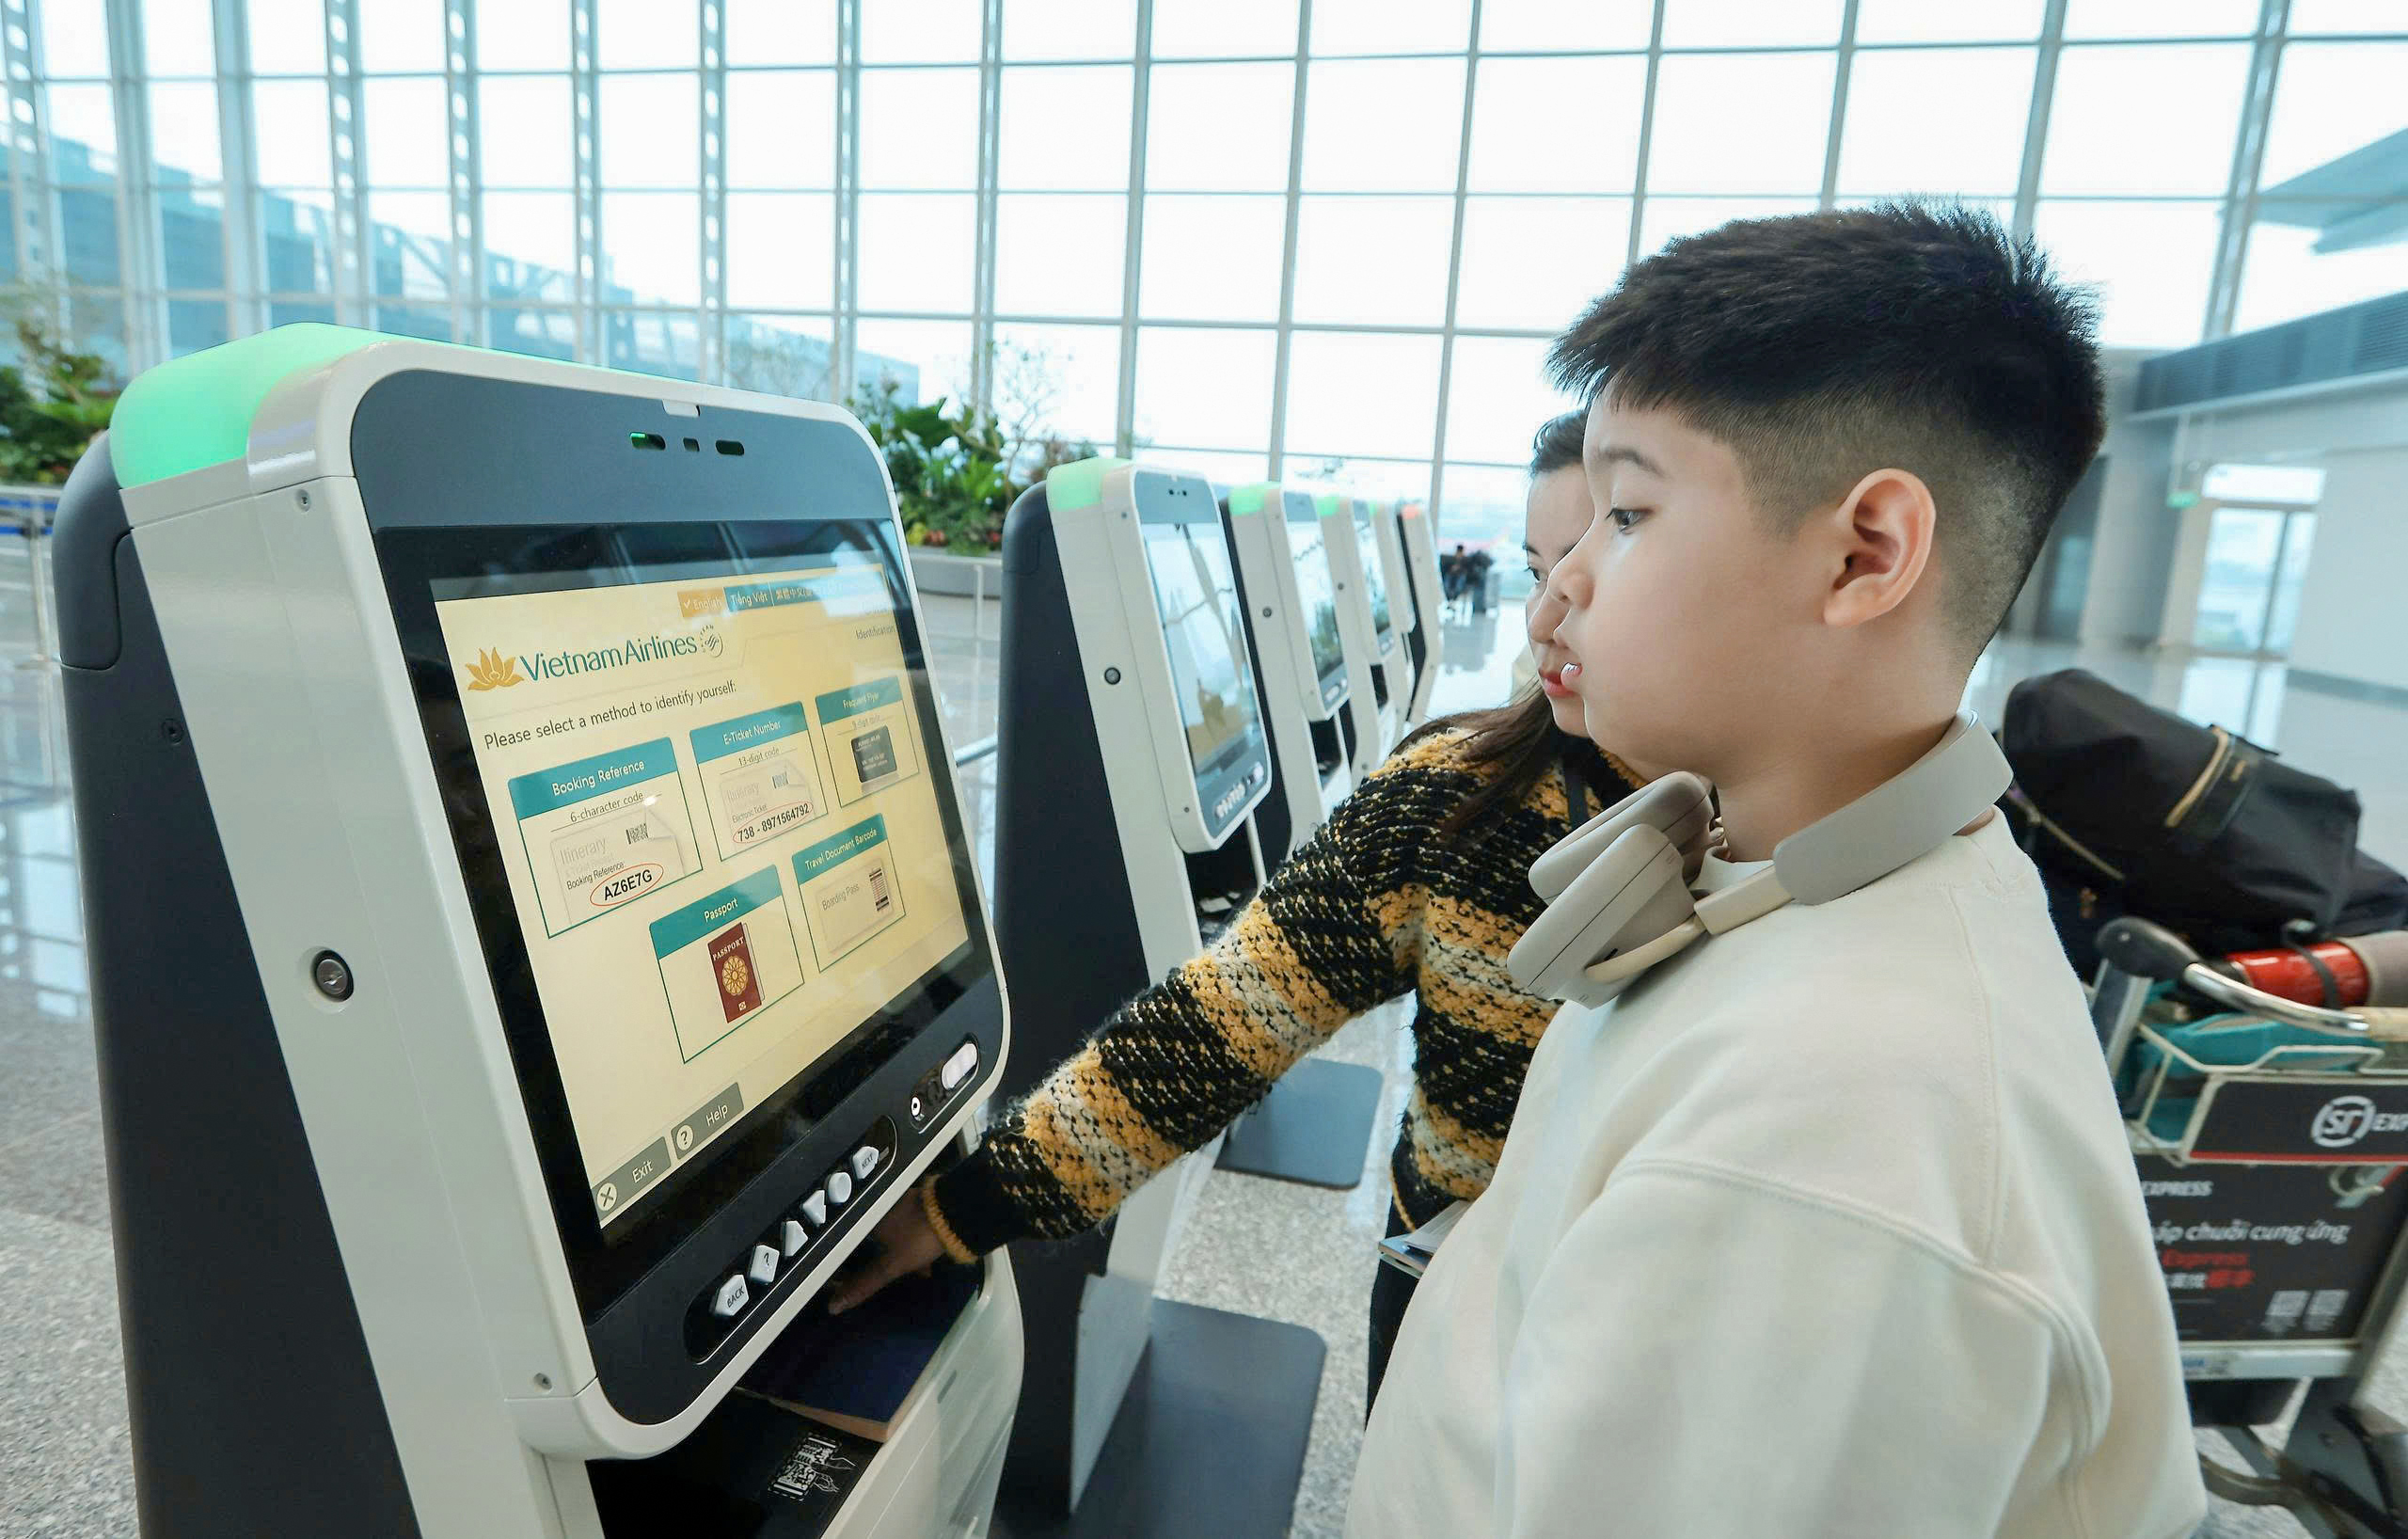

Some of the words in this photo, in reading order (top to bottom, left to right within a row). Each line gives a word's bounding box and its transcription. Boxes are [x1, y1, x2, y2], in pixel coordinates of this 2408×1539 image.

[483, 728, 531, 750] Please
[535, 718, 574, 738] select
[578, 717, 587, 728] a
[590, 706, 637, 726] method
[641, 701, 653, 714] to
[656, 690, 694, 710] identify
[696, 679, 737, 705] yourself:
[722, 727, 753, 745] E-Ticket
[753, 721, 781, 737] Number
[738, 752, 763, 767] 13-digit
[764, 746, 780, 759] code
[551, 773, 596, 797] Booking
[597, 759, 645, 783] Reference
[570, 798, 621, 823] 6-character
[623, 790, 644, 805] code
[737, 825, 755, 842] 738
[761, 802, 810, 833] 8971564792
[560, 837, 607, 865] Itinerary
[804, 852, 825, 871] Travel
[825, 838, 855, 861] Document
[854, 827, 878, 846] Barcode
[566, 874, 594, 890] Booking
[604, 869, 653, 901] AZ6E7G
[704, 897, 738, 923] Passport
[822, 889, 847, 912] Boarding
[846, 882, 860, 896] Pass
[712, 936, 744, 961] PASSPORT
[705, 1103, 729, 1127] Help
[632, 1160, 654, 1183] Exit
[862, 1154, 874, 1170] NEXT
[726, 1285, 746, 1309] BACK
